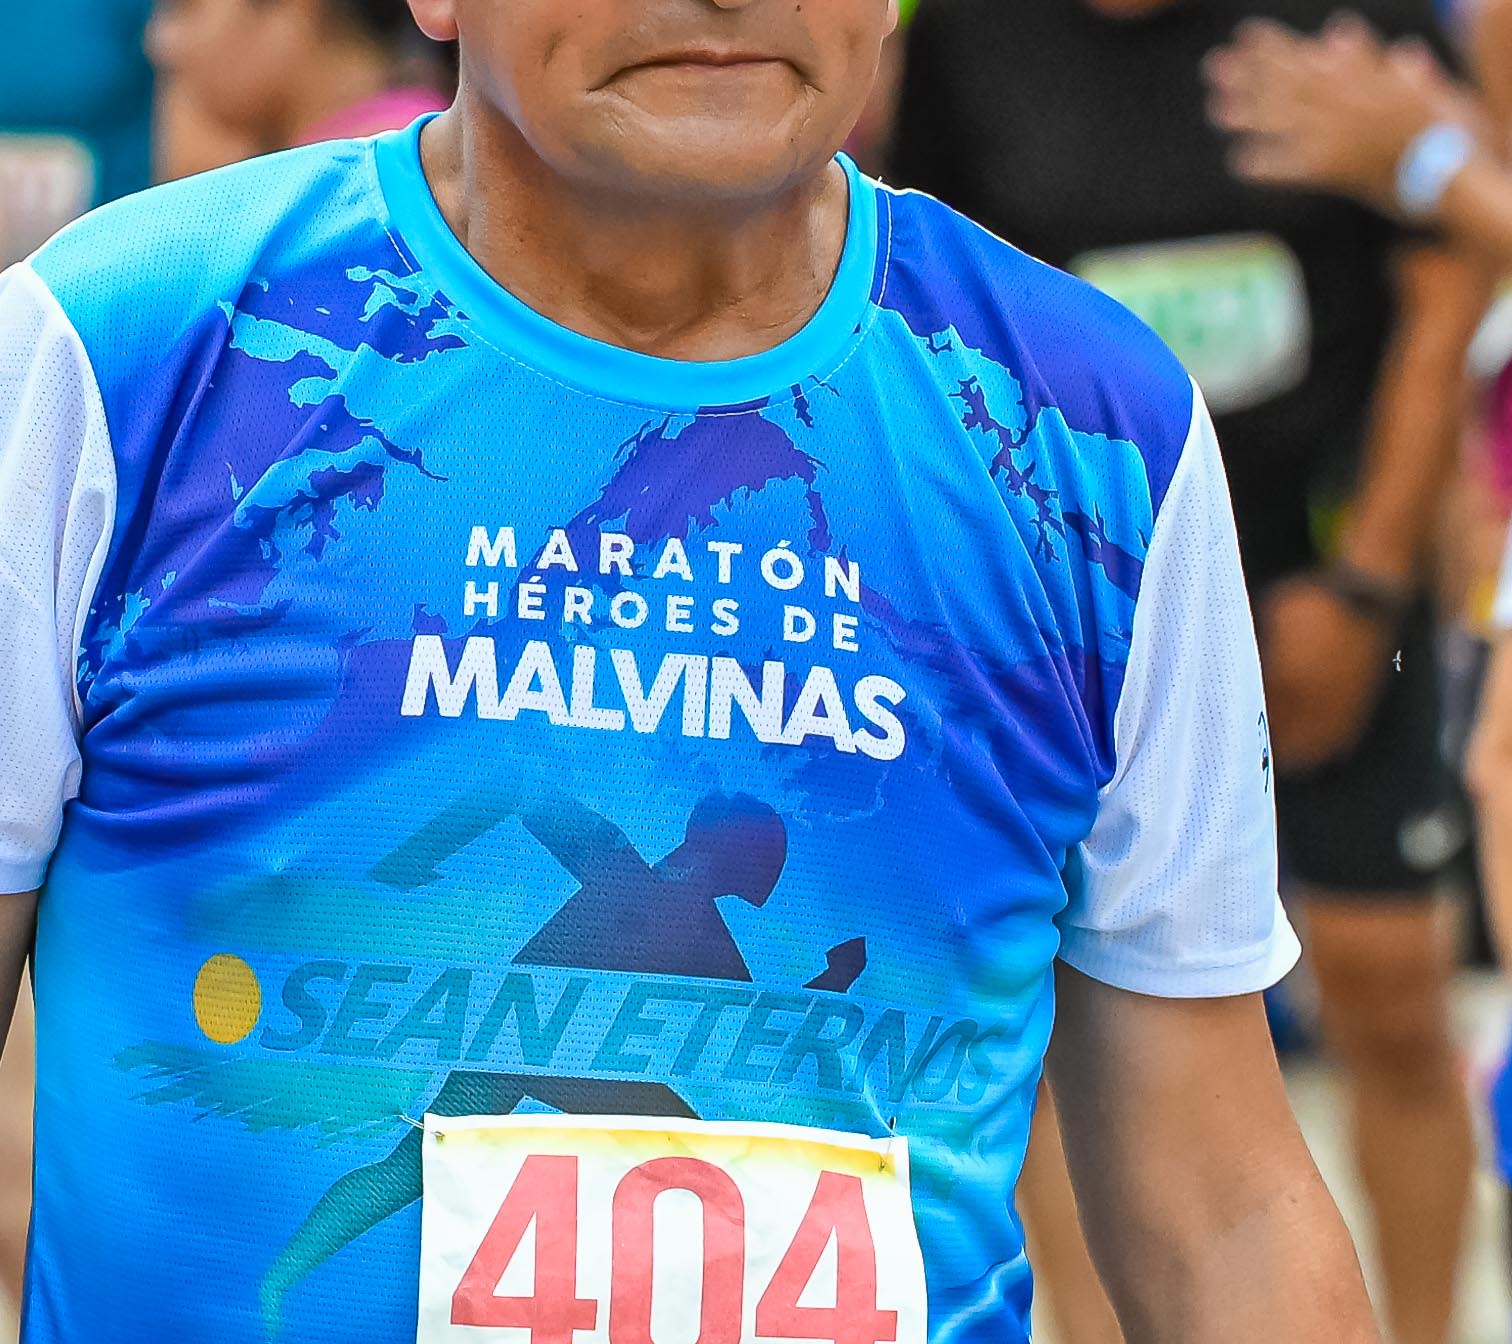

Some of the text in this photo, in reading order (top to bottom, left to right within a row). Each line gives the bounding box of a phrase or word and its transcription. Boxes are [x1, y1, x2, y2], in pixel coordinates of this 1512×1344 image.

[464, 526, 860, 602] MARATÓN
[462, 577, 859, 652] HÉROES DE
[400, 634, 906, 761] MALVINAS
[257, 960, 593, 1064] SEAN
